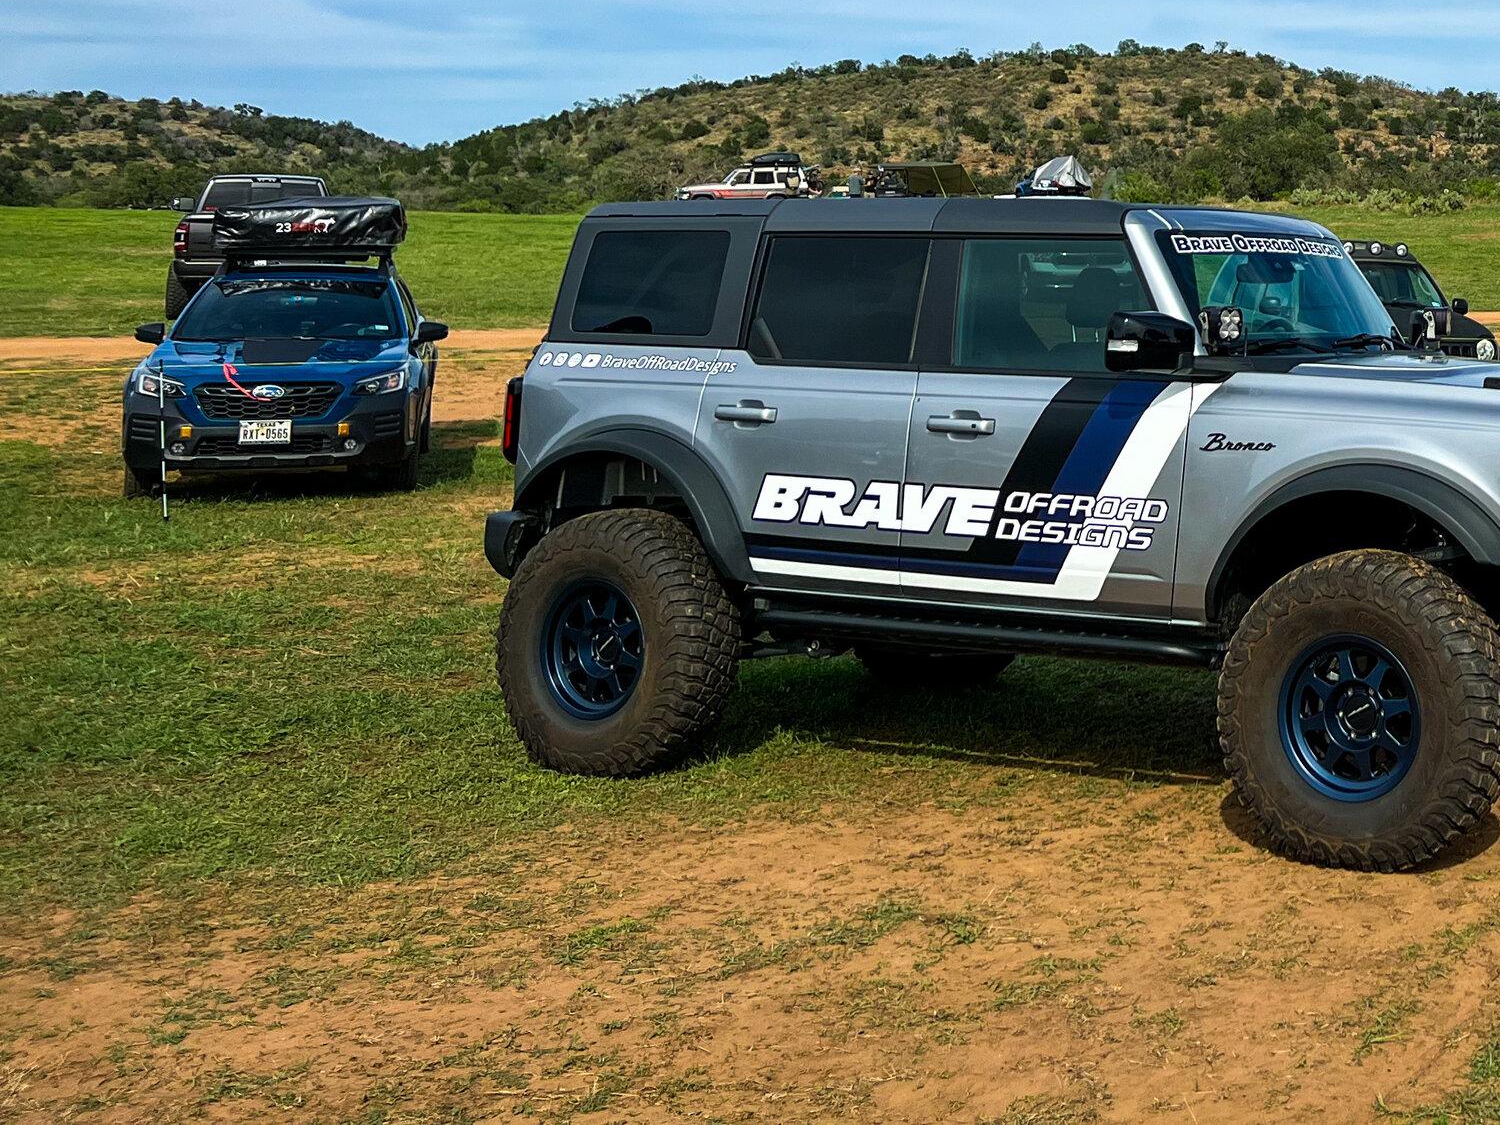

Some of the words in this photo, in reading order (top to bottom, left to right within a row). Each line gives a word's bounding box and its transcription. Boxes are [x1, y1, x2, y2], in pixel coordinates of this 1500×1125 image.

[600, 354, 737, 376] BraveOffRoadDesigns
[1199, 432, 1277, 452] Bronco
[753, 474, 1000, 537] BRAVE
[1003, 491, 1169, 523] OFFROAD
[995, 520, 1154, 550] DESIGNS
